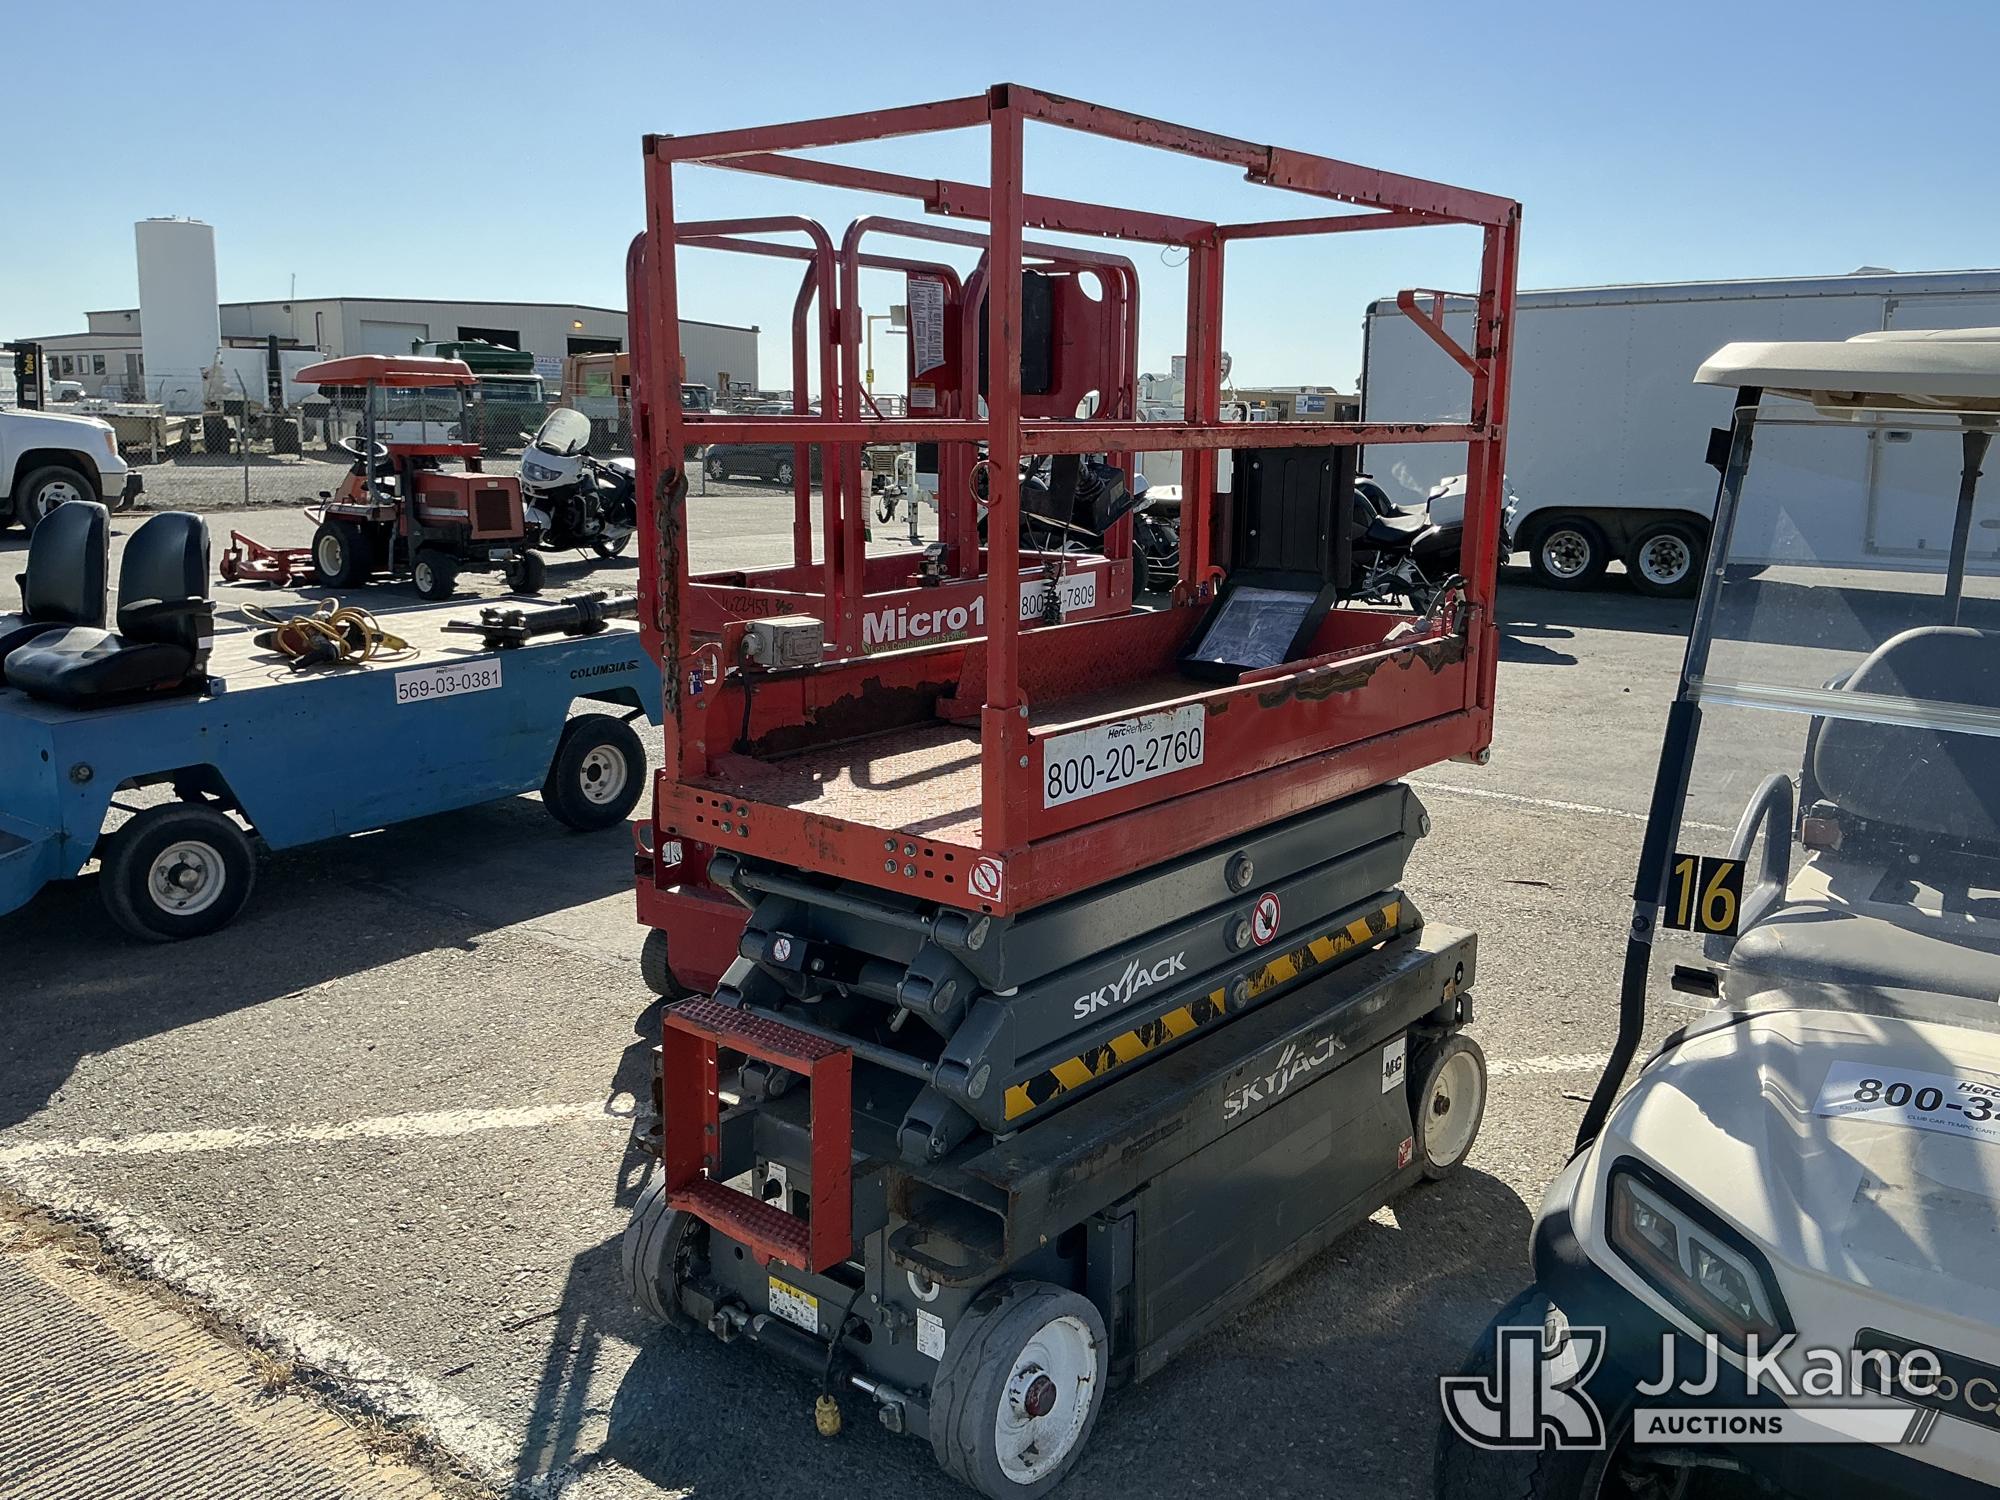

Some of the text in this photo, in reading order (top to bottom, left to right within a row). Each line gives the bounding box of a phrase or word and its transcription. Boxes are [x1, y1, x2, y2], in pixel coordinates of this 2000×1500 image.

[942, 630, 968, 641] System
[398, 669, 500, 700] 569-03-0381
[570, 661, 627, 680] COLUMBIA
[1047, 727, 1201, 799] 800-20-2760
[1675, 858, 1736, 931] 16
[1073, 951, 1187, 1020] SKYJACK
[1223, 1033, 1346, 1120] SKYJACK
